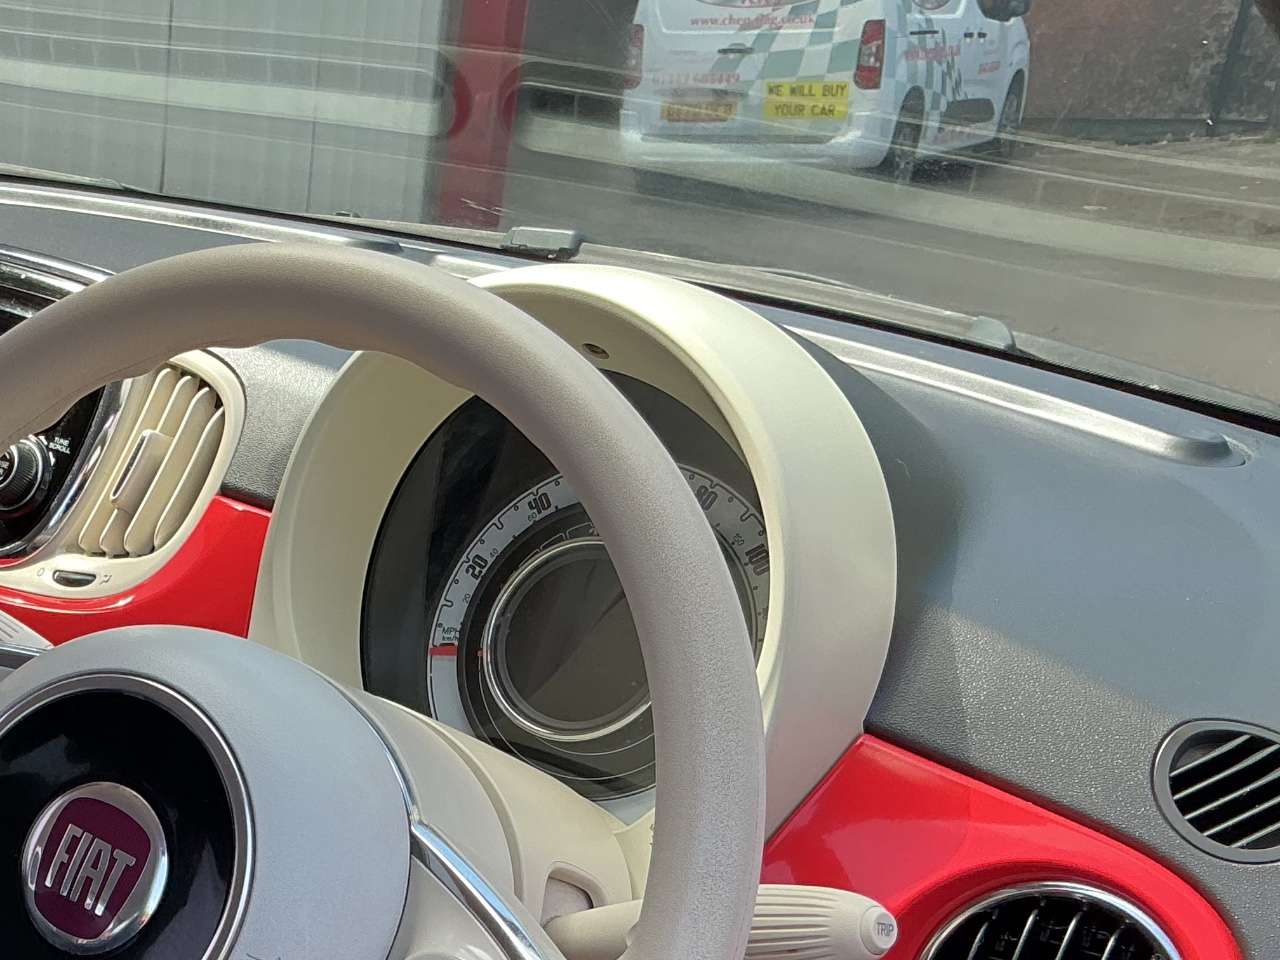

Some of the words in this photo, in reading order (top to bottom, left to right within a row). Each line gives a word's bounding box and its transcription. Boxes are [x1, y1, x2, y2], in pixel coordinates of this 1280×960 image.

[768, 84, 784, 97] WE
[790, 84, 816, 97] WILL
[822, 84, 847, 97] BUY
[774, 103, 805, 117] YOUR
[811, 104, 835, 117] CAR
[48, 442, 71, 454] SCROLL
[54, 436, 70, 447] TUNE
[527, 492, 552, 515] 40
[465, 554, 488, 581] 20
[745, 543, 770, 577] 100
[43, 823, 137, 917] FIAT
[877, 921, 894, 937] TRIP
